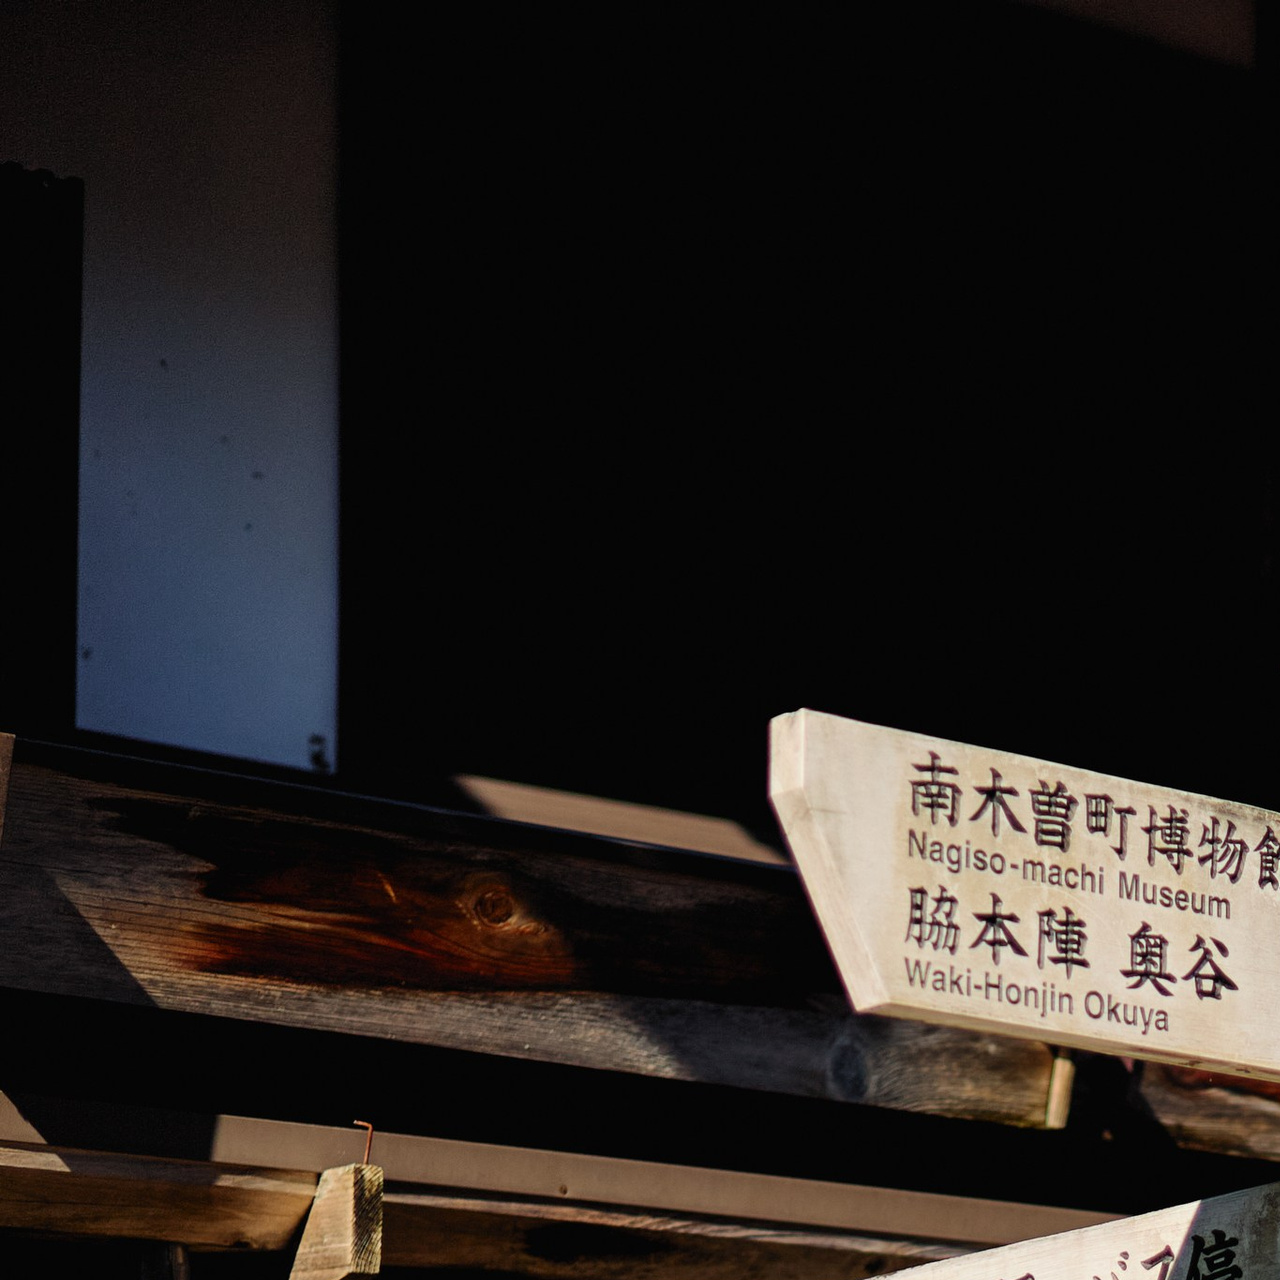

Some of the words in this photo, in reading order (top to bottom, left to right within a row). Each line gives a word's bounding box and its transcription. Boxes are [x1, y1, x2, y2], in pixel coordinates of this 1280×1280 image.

[907, 829, 1105, 895] Nagiso-machi
[1118, 872, 1232, 919] Museum
[904, 885, 1090, 979] 脇本陣
[1120, 920, 1240, 1001] 奥谷
[904, 957, 1074, 1018] Waki-Honjin
[1084, 992, 1170, 1035] Okuya
